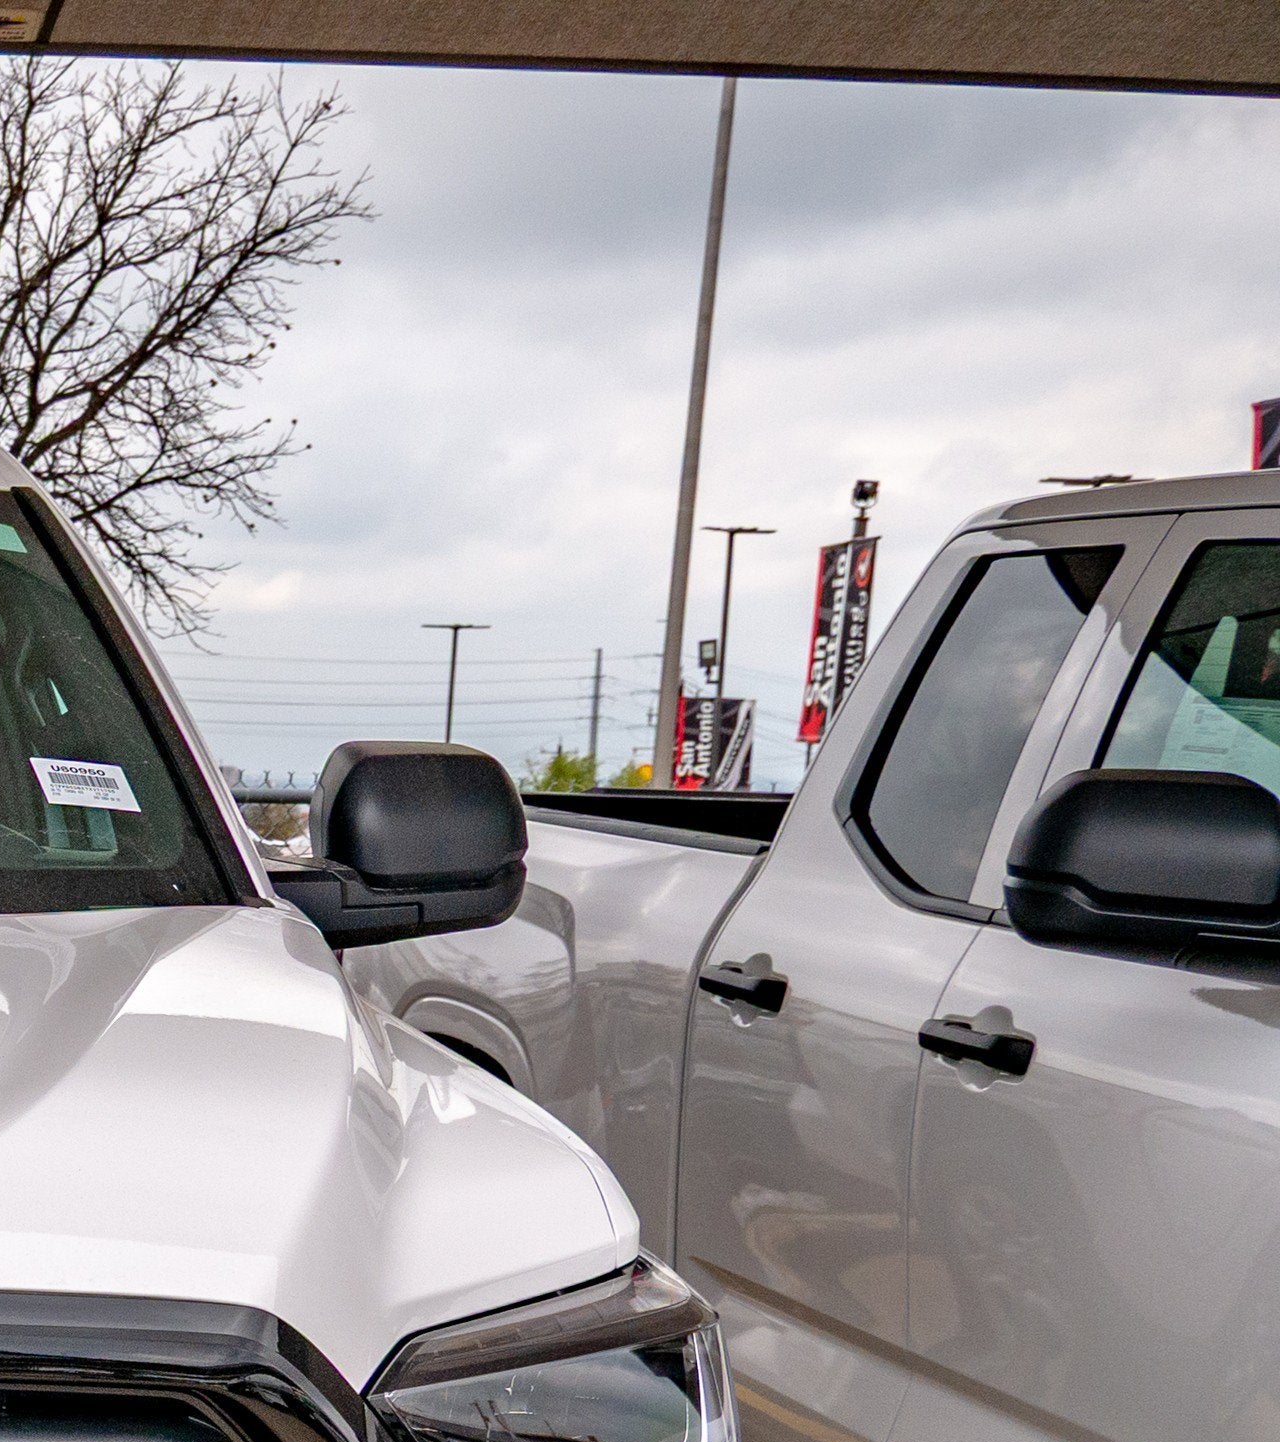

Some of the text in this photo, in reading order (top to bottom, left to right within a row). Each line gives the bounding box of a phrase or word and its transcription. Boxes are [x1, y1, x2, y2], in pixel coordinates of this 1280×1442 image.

[804, 636, 828, 707] San
[675, 740, 696, 777] San
[692, 701, 715, 778] Antonio
